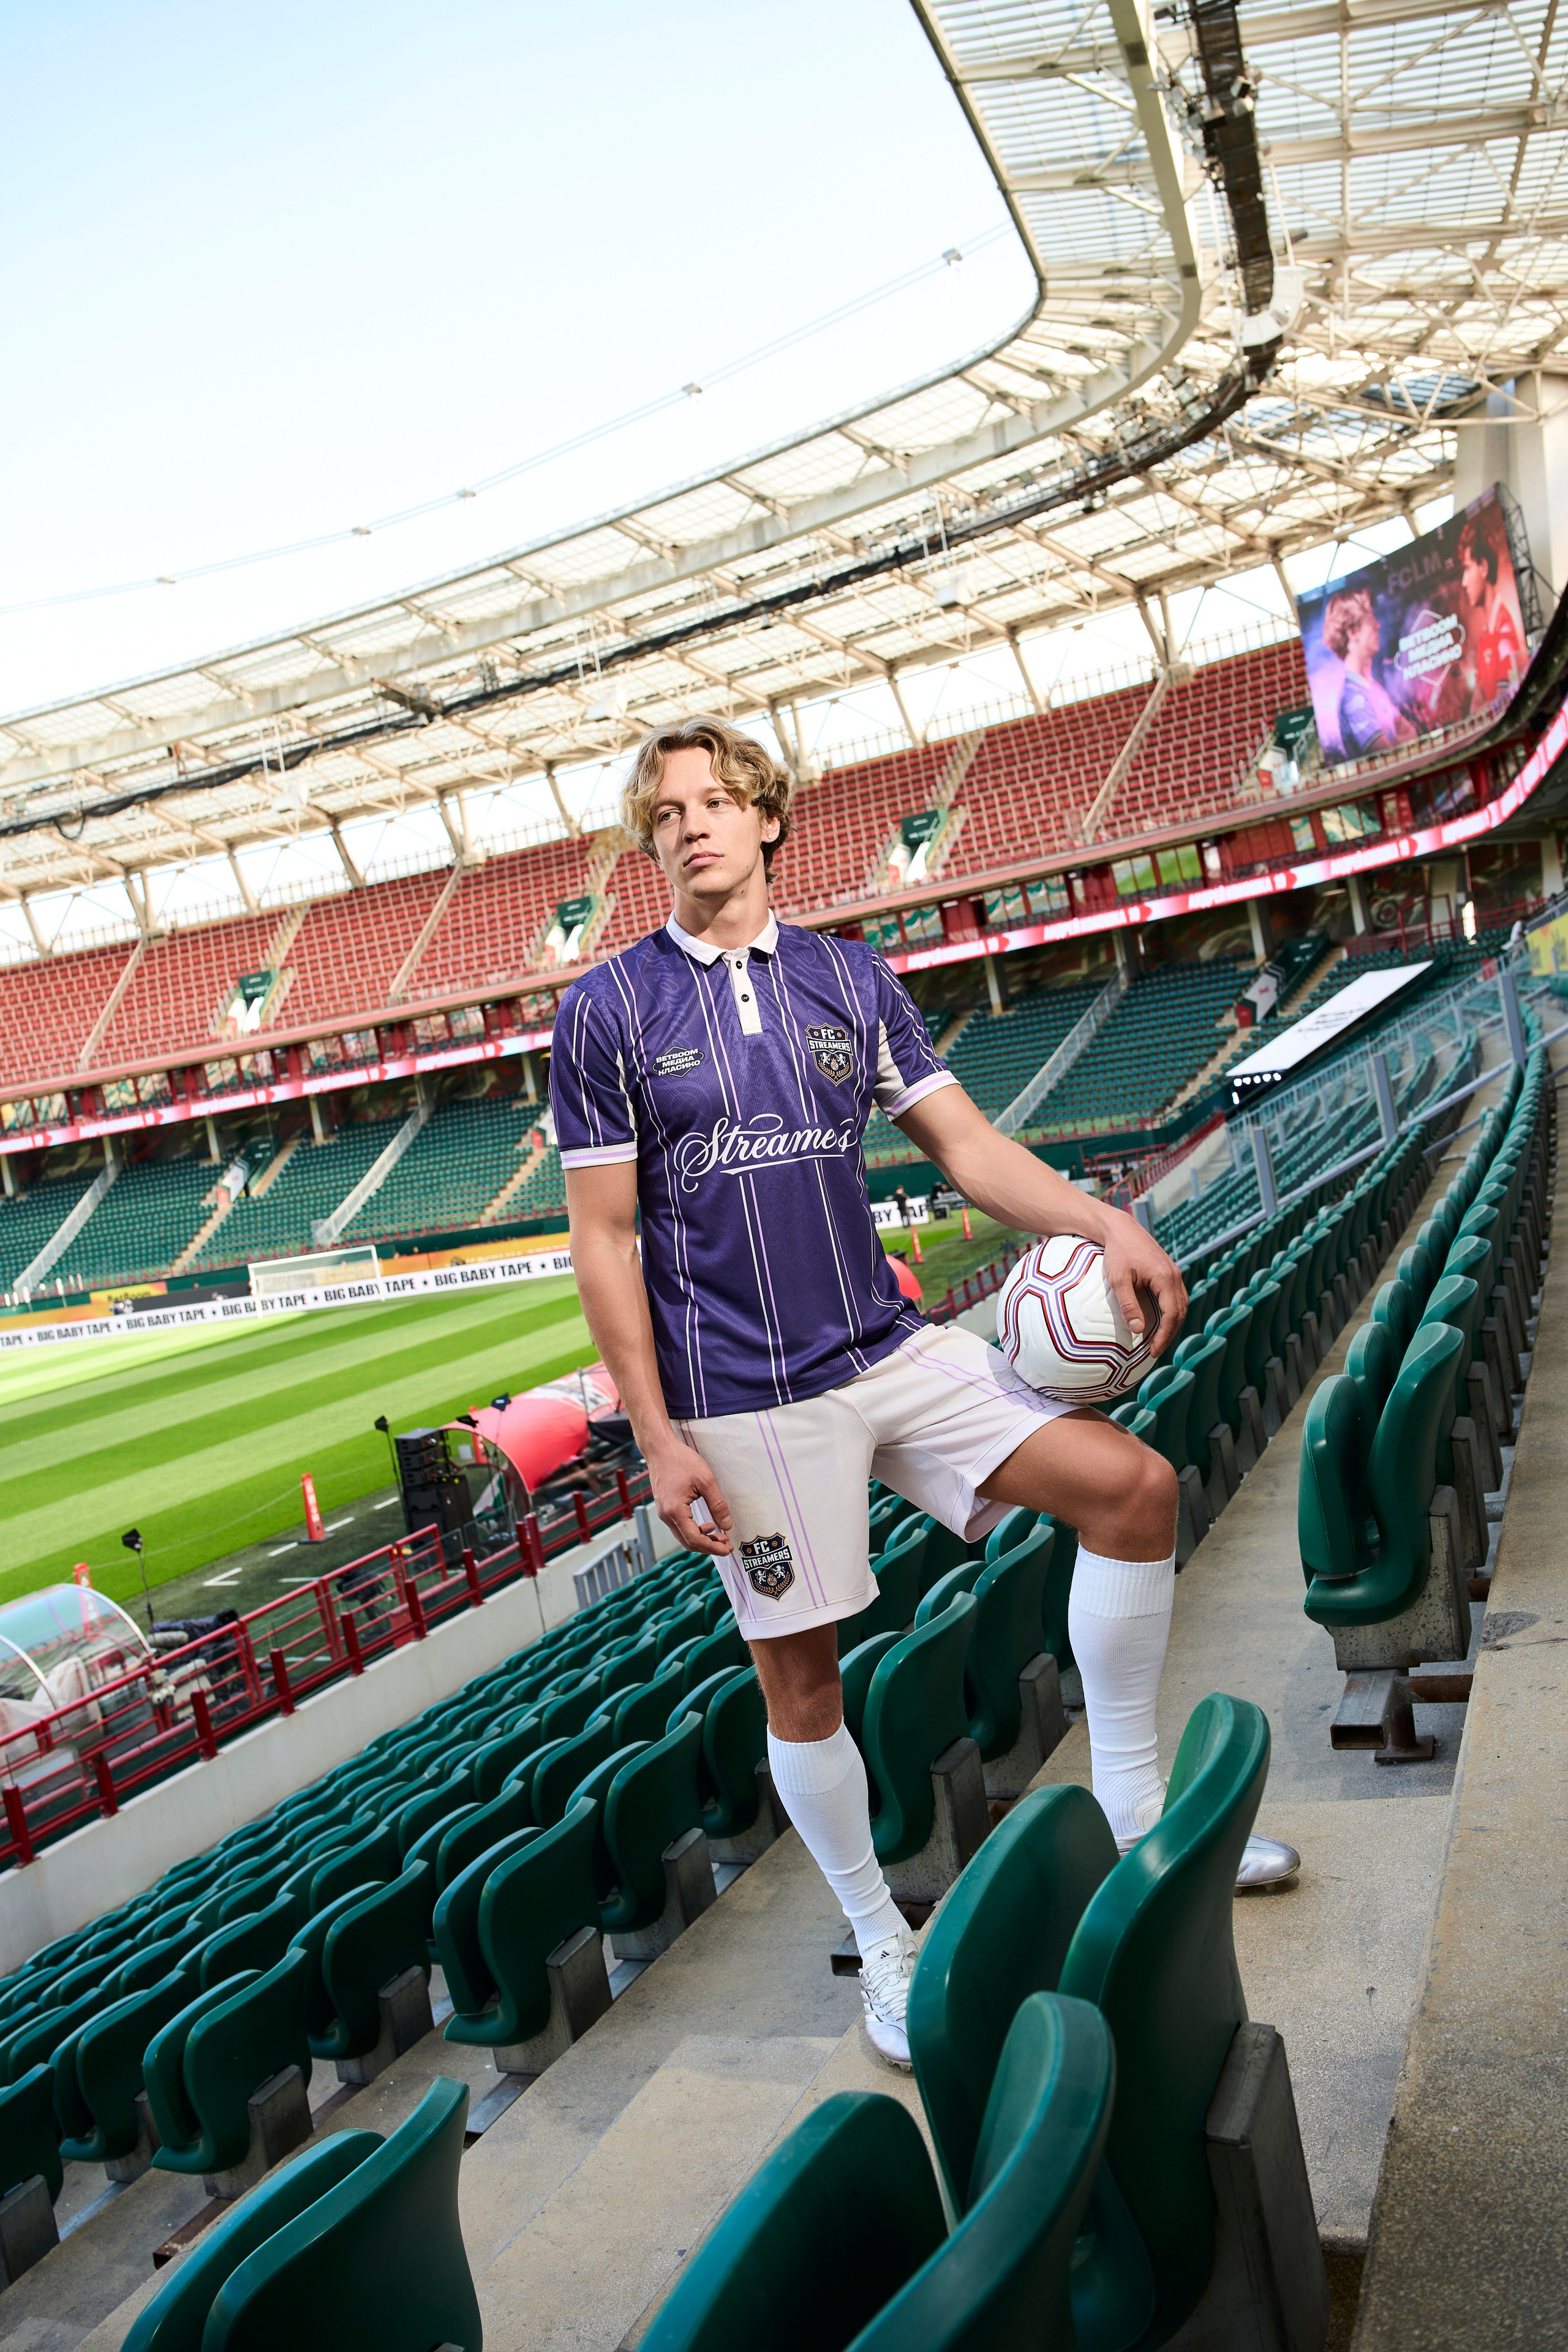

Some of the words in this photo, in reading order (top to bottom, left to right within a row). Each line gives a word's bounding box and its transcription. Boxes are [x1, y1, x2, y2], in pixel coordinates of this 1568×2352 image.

[821, 1029, 835, 1040] FC
[809, 1040, 851, 1052] STREAMERS
[656, 1048, 698, 1063] BETBOOM
[662, 1055, 695, 1068] МЕДИА
[658, 1060, 701, 1076] КЛАСИКО
[674, 1114, 858, 1193] Streames
[1, 1335, 22, 1346] TAPE
[37, 1329, 55, 1341] BIG
[58, 1326, 83, 1339] BABY
[87, 1322, 111, 1335] TAPE
[127, 1317, 145, 1329] BIG
[148, 1313, 176, 1326] BABY
[180, 1308, 205, 1322] TAPE
[222, 1303, 241, 1316] BIG
[278, 1294, 307, 1308] TAPE
[324, 1288, 345, 1301] BIG
[385, 1278, 415, 1292] TAPE
[435, 1272, 458, 1286] BIG
[461, 1267, 496, 1282] BABY
[500, 1262, 532, 1276] TAPE
[753, 1540, 770, 1555] FC
[744, 1548, 790, 1569] STREAMERS
